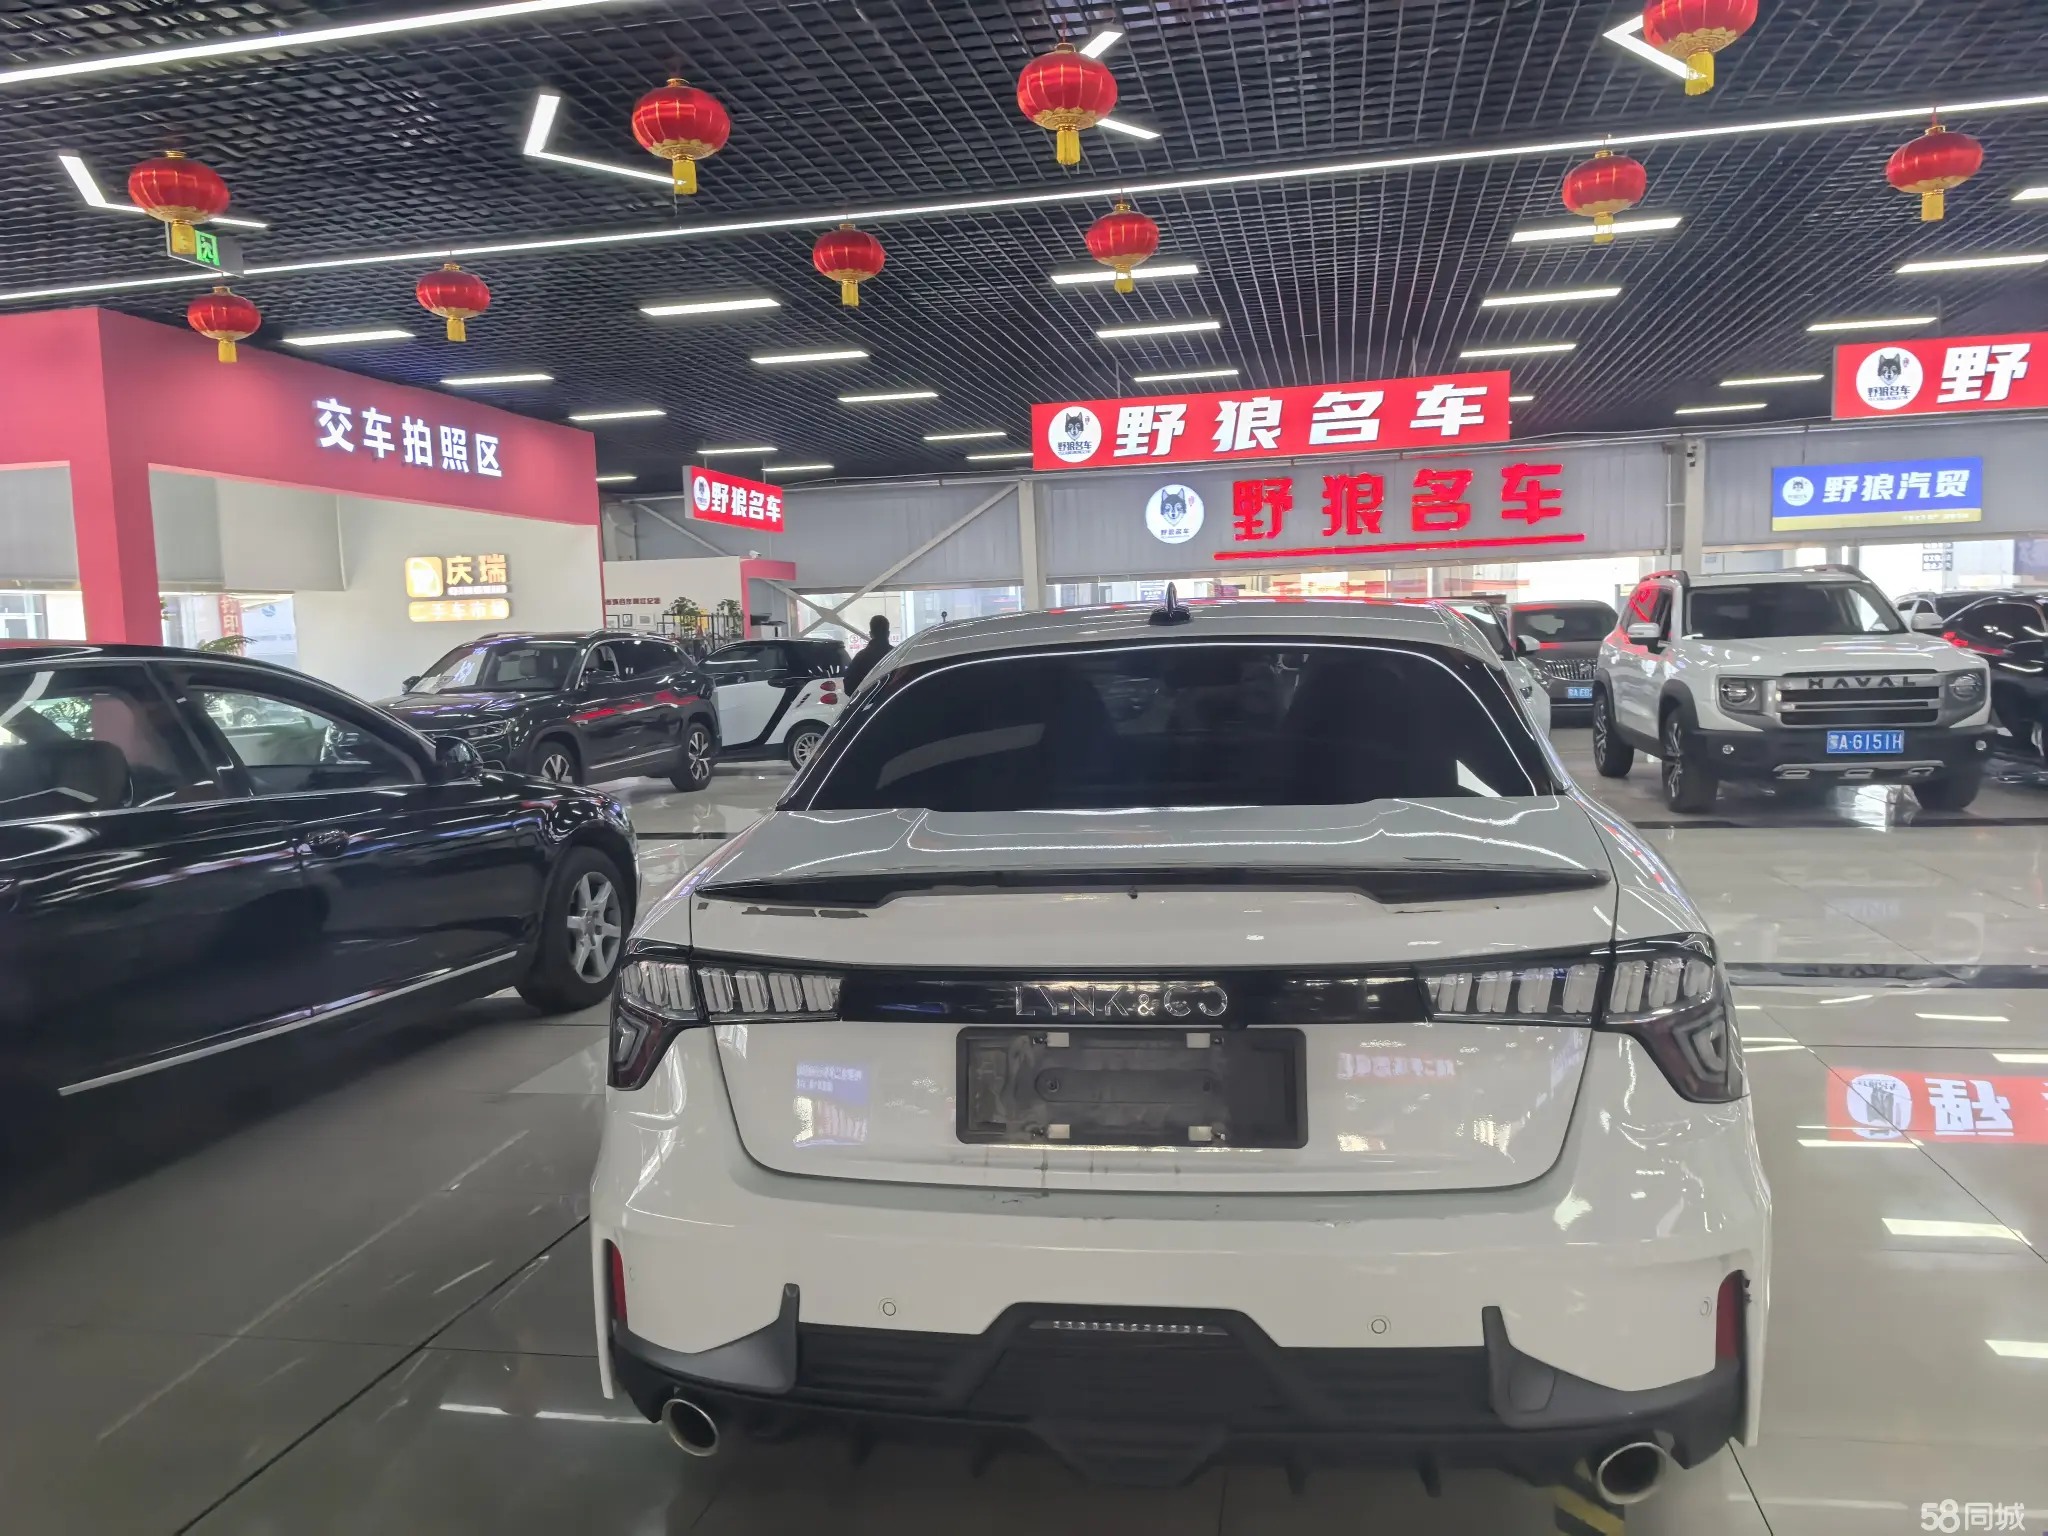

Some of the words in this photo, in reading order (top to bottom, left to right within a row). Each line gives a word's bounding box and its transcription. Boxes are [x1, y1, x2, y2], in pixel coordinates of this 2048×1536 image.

[1936, 343, 2032, 403] 野
[312, 398, 502, 477] 交车拍照区
[1113, 383, 1488, 457] 野狼名车
[711, 481, 781, 522] 野狼名车
[1233, 462, 1564, 542] 野狼名车
[1822, 469, 1970, 503] 野狼汽贸
[446, 554, 506, 585] 庆瑞
[1808, 676, 1917, 690] HAVAL
[1015, 985, 1228, 1017] LYNK&CO
